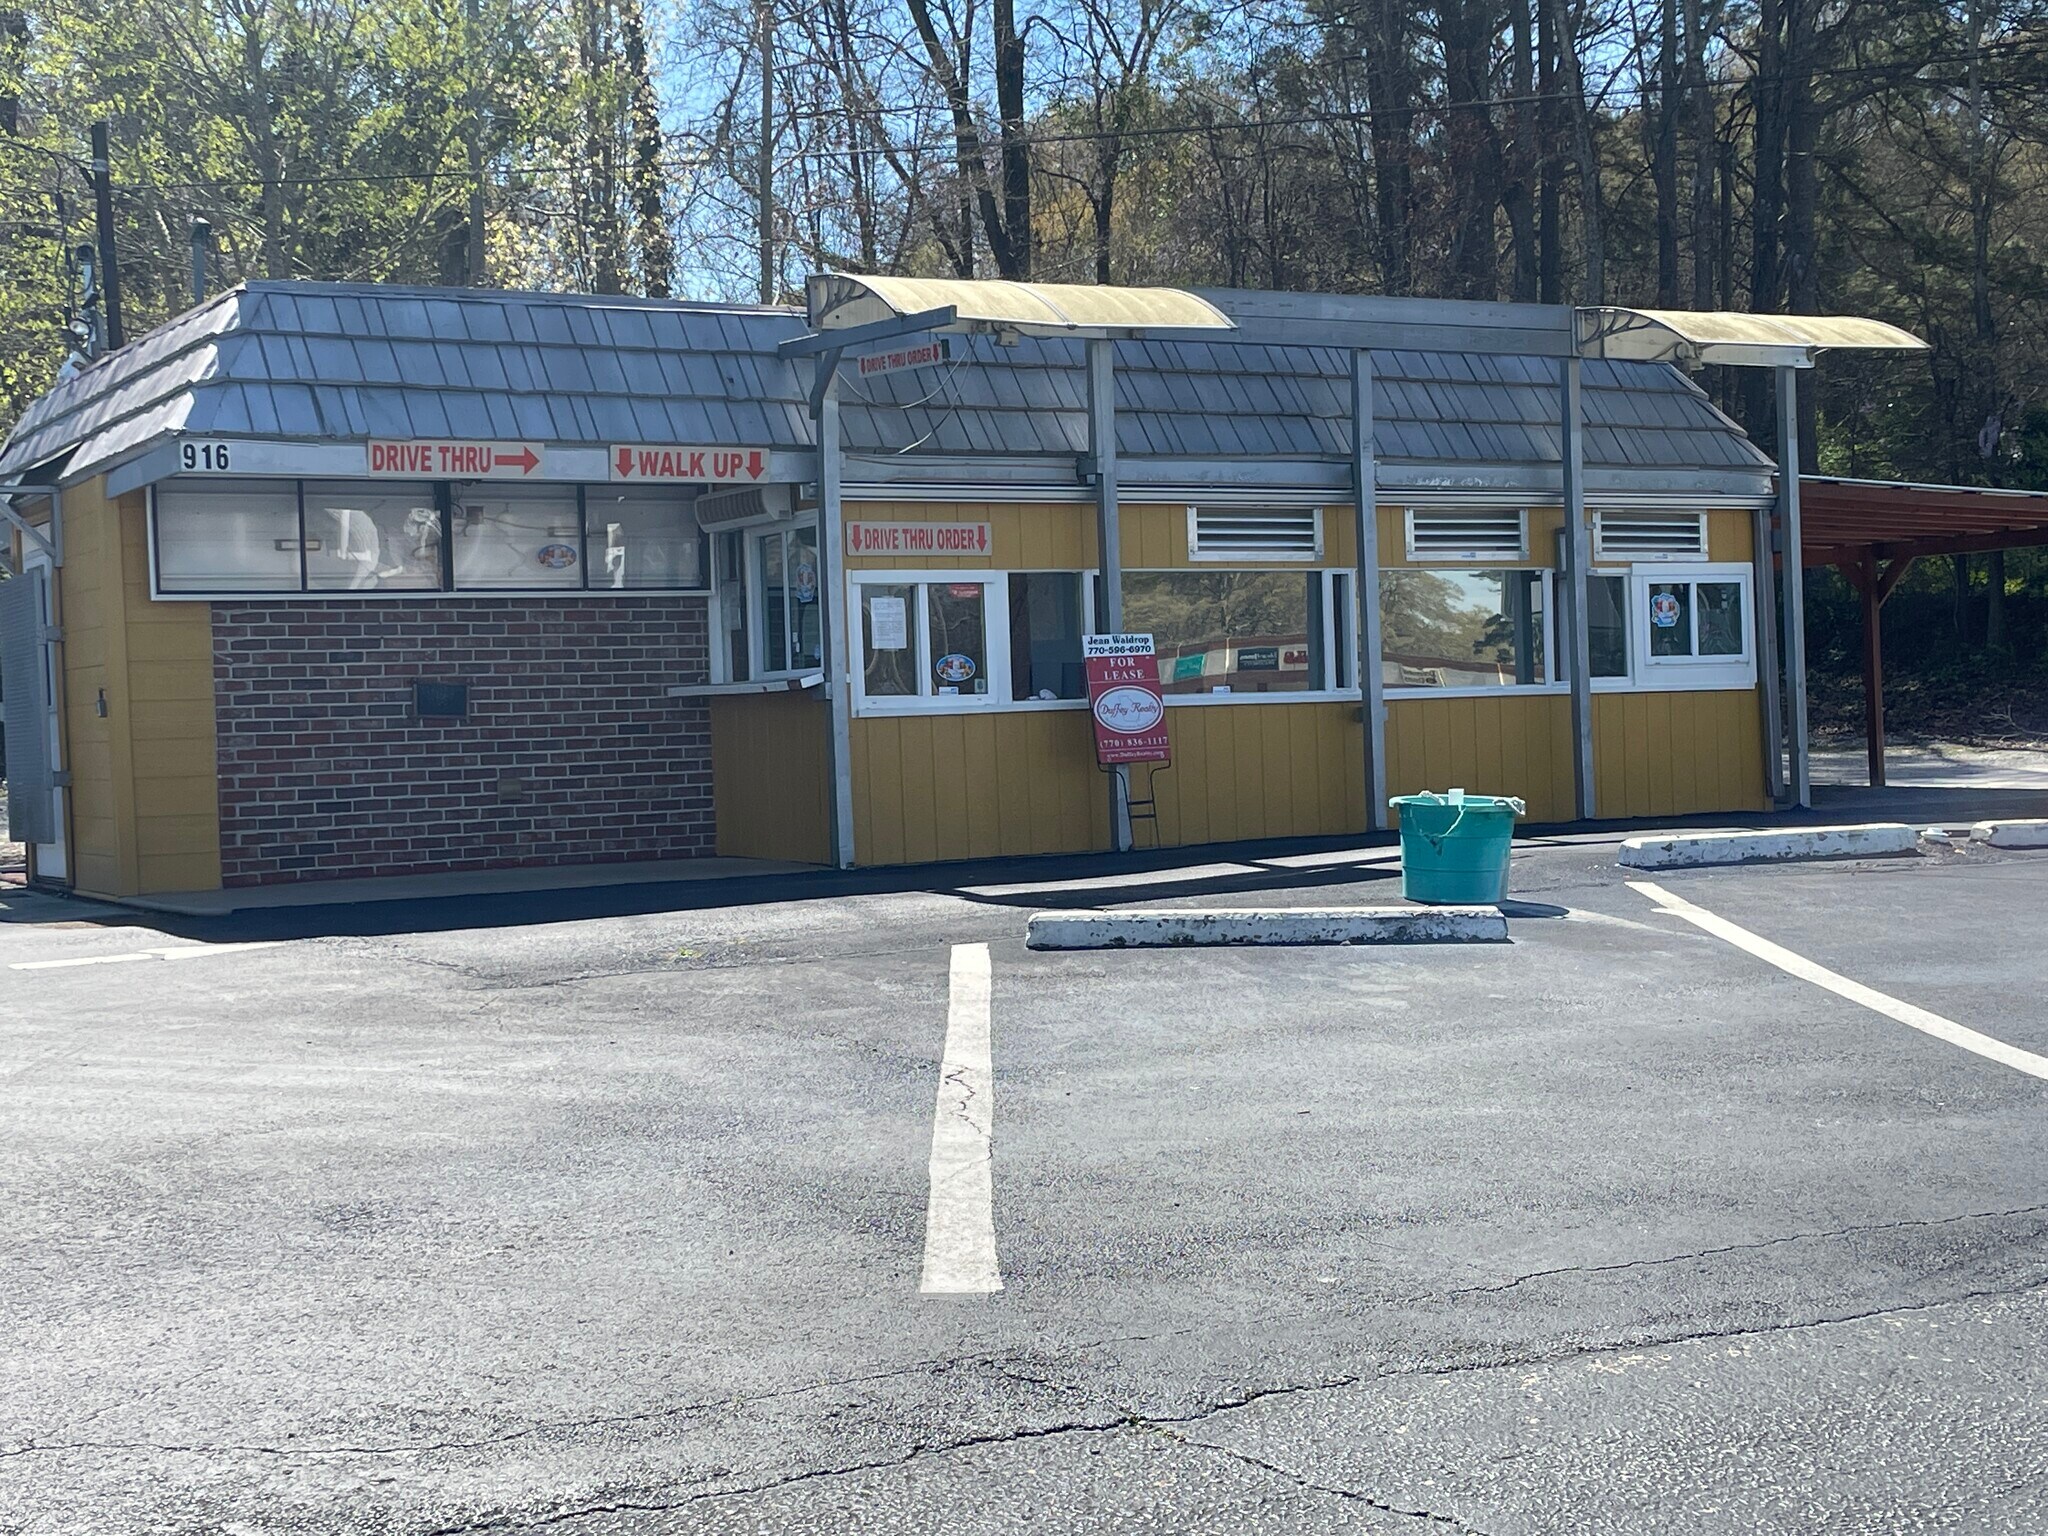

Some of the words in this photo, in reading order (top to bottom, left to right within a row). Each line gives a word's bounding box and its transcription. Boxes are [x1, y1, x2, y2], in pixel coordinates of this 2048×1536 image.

[866, 355, 887, 373] DRIVE
[888, 352, 906, 369] THRU
[907, 347, 932, 366] ORDER
[183, 444, 229, 470] 916
[372, 444, 432, 472] DRIVE
[438, 446, 491, 473] THRU
[638, 451, 706, 477] WALK
[713, 452, 744, 478] UP
[864, 528, 899, 550] DRIVE
[902, 528, 934, 550] THRU
[937, 528, 976, 550] ORDER
[1087, 636, 1110, 645] Jean
[1112, 635, 1150, 645] Waldrop
[1088, 645, 1151, 655] 770-596-6970
[1109, 657, 1135, 667] FOR
[1104, 669, 1145, 680] LEASE
[1100, 739, 1124, 749] (770)
[1127, 736, 1168, 746] 836-1117
